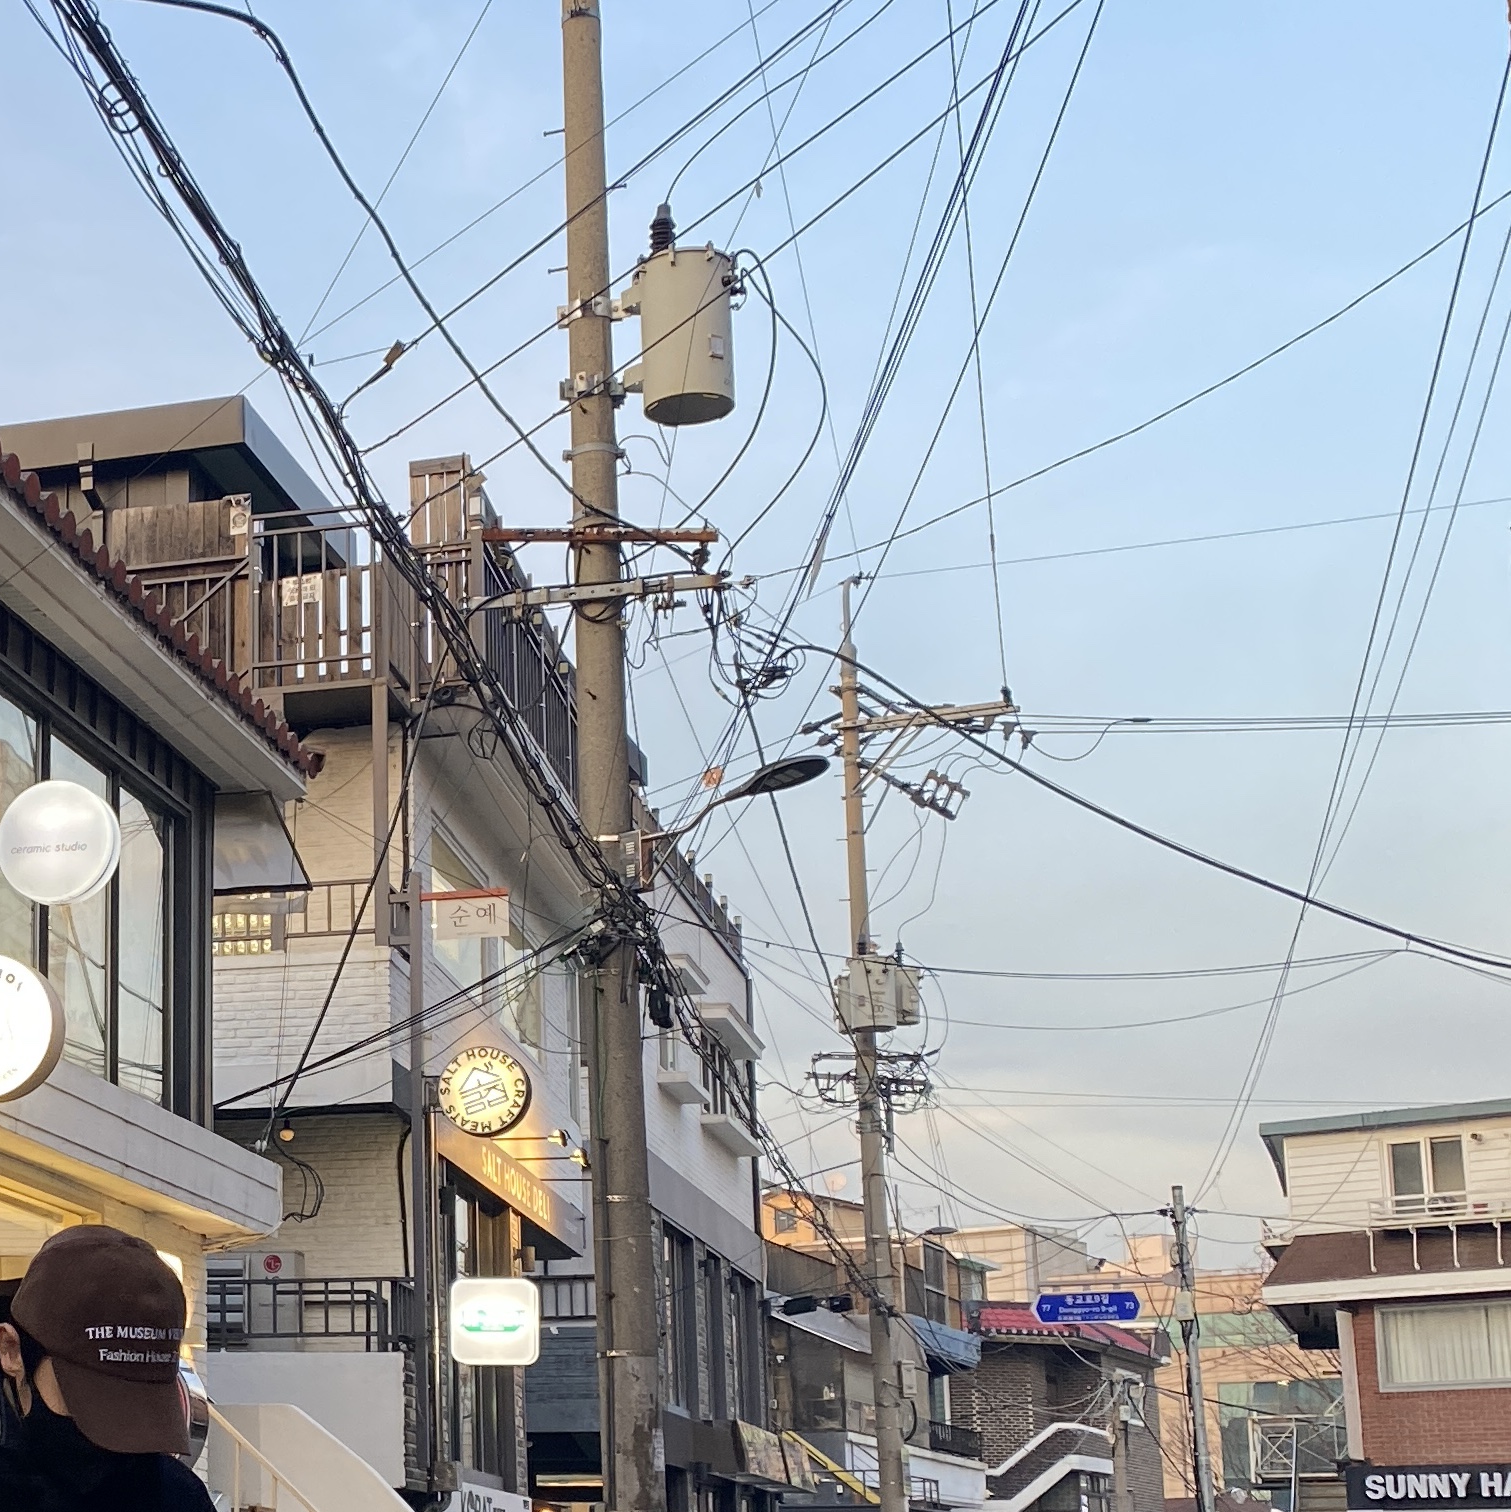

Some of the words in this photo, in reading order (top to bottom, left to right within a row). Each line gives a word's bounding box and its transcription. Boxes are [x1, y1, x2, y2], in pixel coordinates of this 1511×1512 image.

[10, 845, 51, 855] ceramic
[54, 840, 88, 852] studio
[448, 902, 497, 928] 순예
[465, 1047, 518, 1073] HOUSE
[439, 1057, 462, 1096] SALT
[496, 1078, 526, 1127] CRAFT
[445, 1104, 493, 1132] MEATS
[481, 1145, 502, 1186] SALT
[503, 1161, 532, 1209] HOUSE
[532, 1185, 551, 1223] DELI
[85, 1326, 114, 1340] THE
[116, 1325, 168, 1340] MUSEUM
[98, 1348, 145, 1363] Fashion
[1365, 1473, 1471, 1500] SUNNY
